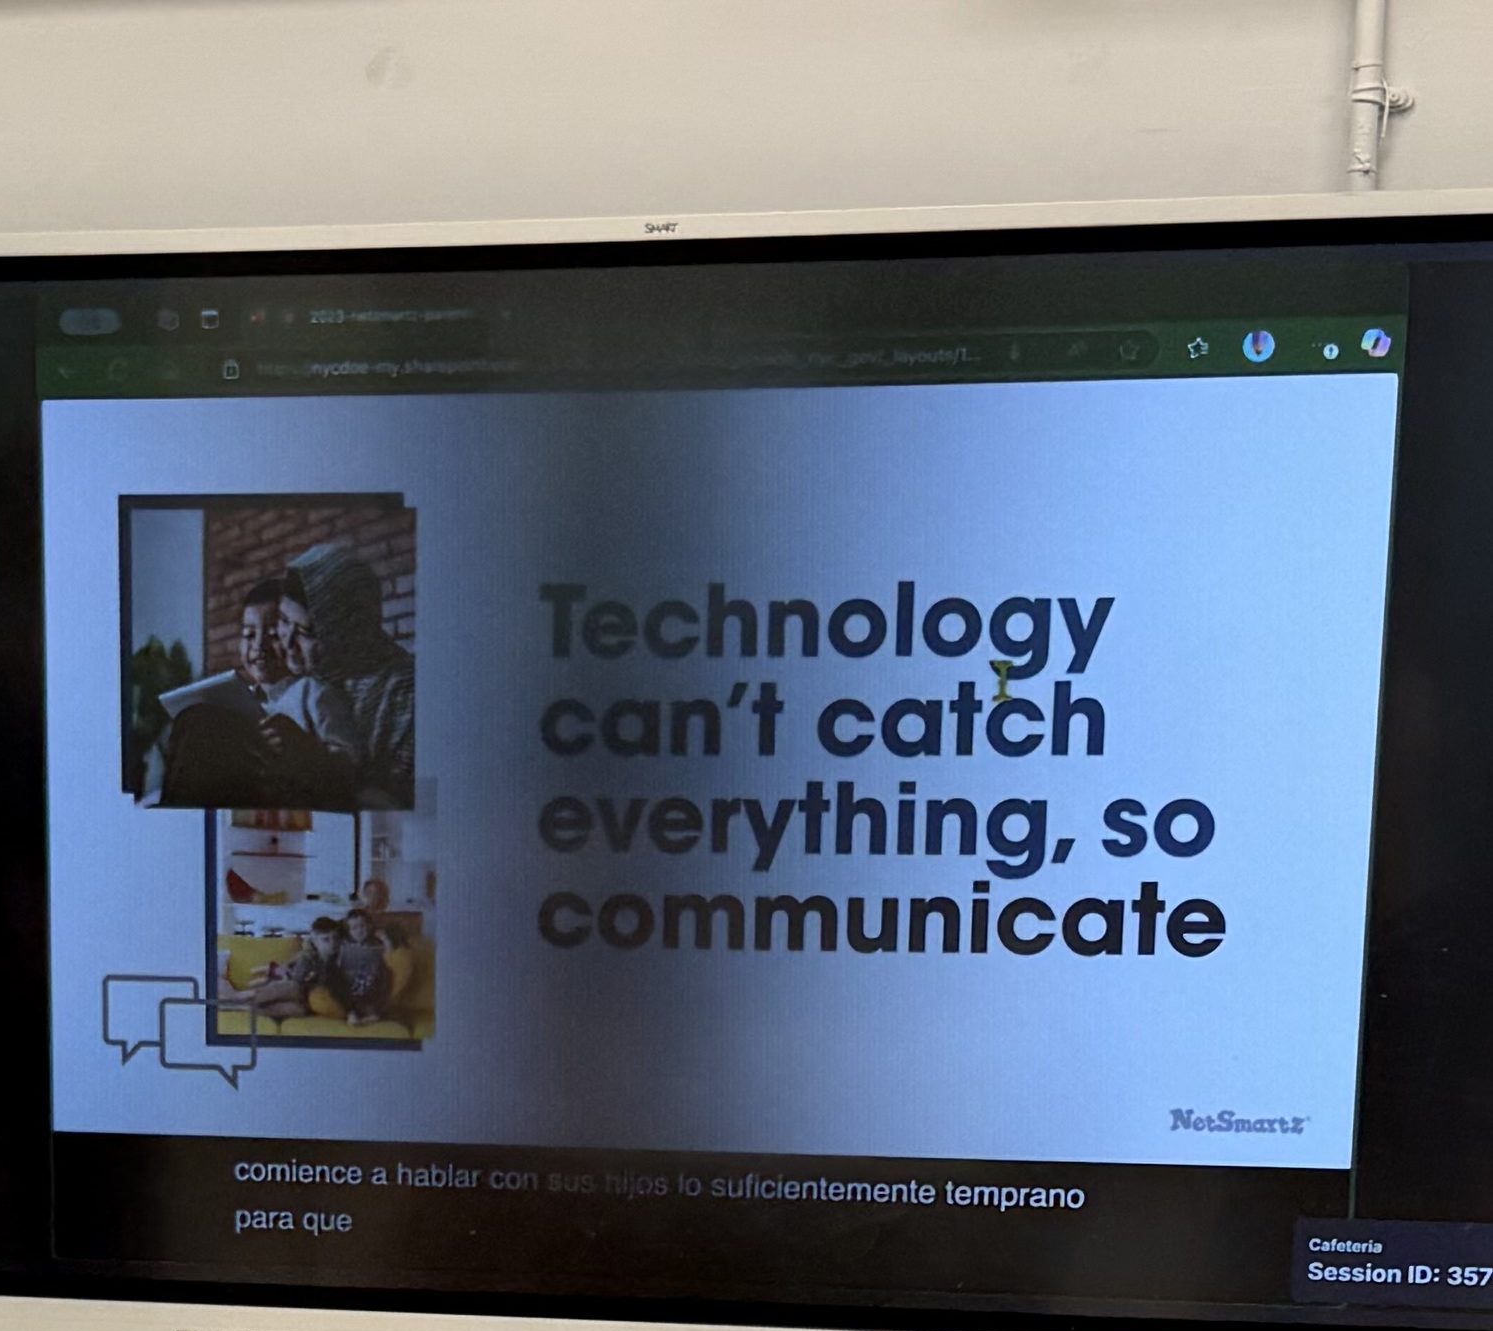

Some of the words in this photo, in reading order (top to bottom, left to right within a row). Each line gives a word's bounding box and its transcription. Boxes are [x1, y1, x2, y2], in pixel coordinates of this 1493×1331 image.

[539, 581, 1116, 681] Technology
[539, 681, 784, 757] can't
[818, 681, 1105, 757] catch
[537, 781, 1075, 879] everything,
[1101, 798, 1216, 858] so
[537, 881, 1227, 957] communicate
[1170, 1108, 1306, 1134] NetSmartz
[234, 1159, 363, 1184] comience
[371, 1169, 387, 1185] a
[397, 1163, 479, 1189] hablar
[489, 1172, 538, 1192] con
[548, 1174, 595, 1194] sus
[607, 1171, 667, 1200] hijos
[678, 1174, 703, 1196] lo
[711, 1173, 936, 1204] suficientemente
[945, 1180, 1085, 1211] temprano
[234, 1208, 294, 1234] para
[302, 1210, 353, 1236] que
[1308, 1238, 1383, 1254] Cafeteria
[1307, 1262, 1402, 1284] Session
[1408, 1265, 1440, 1285] ID:
[1447, 1266, 1493, 1287] 357
